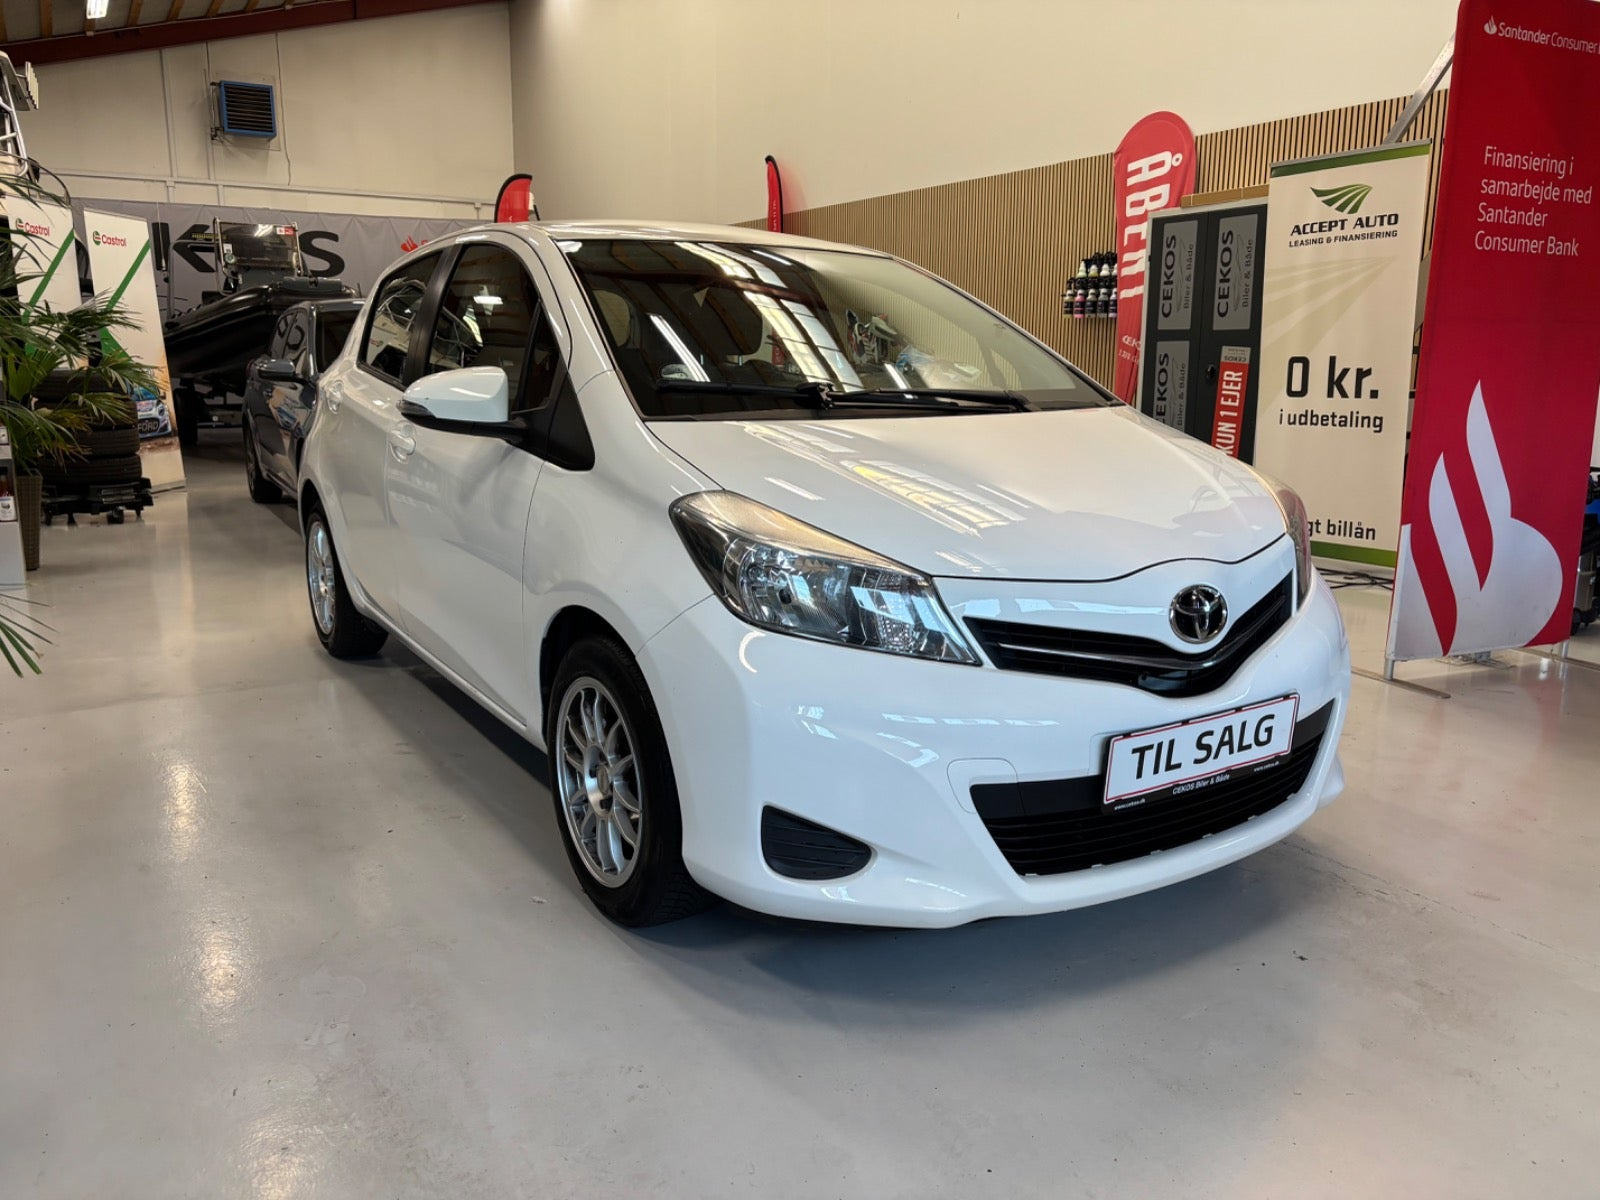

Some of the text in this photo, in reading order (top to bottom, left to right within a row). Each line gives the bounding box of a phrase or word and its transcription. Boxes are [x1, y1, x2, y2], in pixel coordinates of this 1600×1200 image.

[1498, 22, 1551, 45] Santander
[1551, 32, 1598, 54] Consumer
[1484, 146, 1574, 179] Finansiering i
[1480, 178, 1592, 205] samarbejde med
[1290, 213, 1399, 236] ACCEPT AUTO
[1477, 202, 1548, 227] Santander
[25, 222, 50, 237] Castrol
[101, 234, 127, 247] Castrol
[1289, 236, 1324, 248] LEASING
[1333, 230, 1398, 243] FINANSIERING
[1474, 230, 1580, 257] Consumer Bank
[1161, 234, 1177, 318] CEKOS
[1217, 229, 1234, 318] CEKOS
[1220, 370, 1243, 406] EJER
[1286, 355, 1379, 399] 0 kr.
[1279, 408, 1383, 433] i udbetaling
[1215, 422, 1236, 455] KUN
[1327, 518, 1376, 541] billån
[1131, 714, 1275, 780] TIL SALG
[1172, 782, 1195, 795] CEKOS
